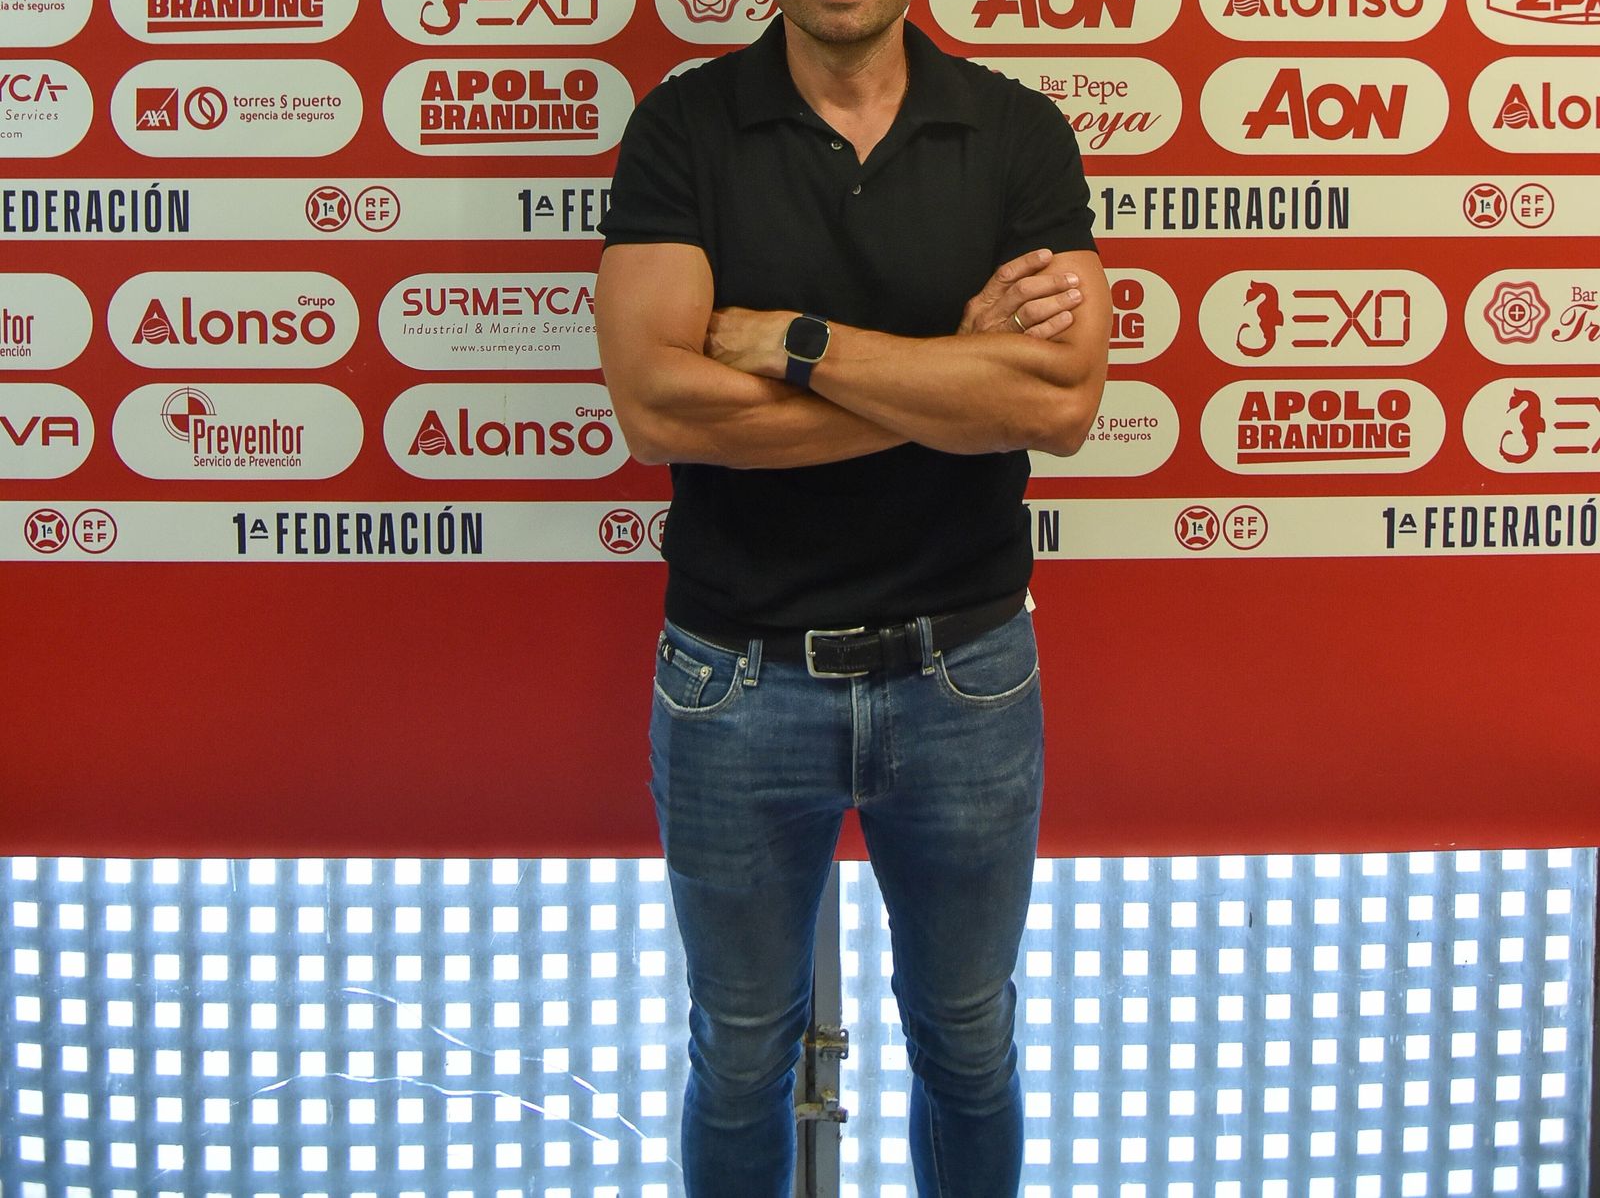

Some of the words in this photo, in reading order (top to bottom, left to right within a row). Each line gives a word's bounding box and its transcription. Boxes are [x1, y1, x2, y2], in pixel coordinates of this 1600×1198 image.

[12, 2, 24, 10] de
[28, 3, 64, 12] seguros
[421, 69, 598, 101] APOLO
[1040, 75, 1067, 91] Bar
[1072, 74, 1128, 105] Pepe
[5, 109, 58, 120] Services
[234, 96, 275, 107] torres
[293, 96, 341, 110] puerto
[1242, 68, 1408, 140] AON
[136, 109, 172, 127] AXA
[240, 111, 278, 122] agencia
[281, 111, 293, 120] de
[297, 113, 334, 122] seguros
[420, 104, 599, 130] BRANDING
[1064, 111, 1162, 150] oya
[3, 183, 189, 232] EDERACIÓN
[1145, 180, 1348, 230] FEDERACIÓN
[298, 296, 335, 307] Grupo
[403, 286, 595, 316] SURMEYCA
[1572, 287, 1597, 302] Bar
[132, 296, 335, 345] Alonso
[404, 323, 468, 334] Industrial
[475, 323, 482, 333] &
[490, 323, 536, 333] Marine
[543, 321, 597, 334] Services
[0, 345, 31, 357] ención
[452, 345, 560, 354] www.surmeyca.com
[575, 407, 613, 420] Grupo
[1239, 390, 1410, 421] APOLO
[193, 418, 304, 454] Preventor
[407, 408, 613, 456] Alonso
[1098, 432, 1110, 440] de
[1114, 434, 1151, 442] seguros
[1110, 417, 1158, 431] puerto
[1237, 422, 1411, 449] BRANDING
[193, 455, 230, 468] Servicio
[235, 456, 246, 466] de
[249, 456, 301, 467] Prevención
[277, 506, 482, 554] FEDERACIÓN
[1425, 498, 1596, 548] FEDERACIÓ
